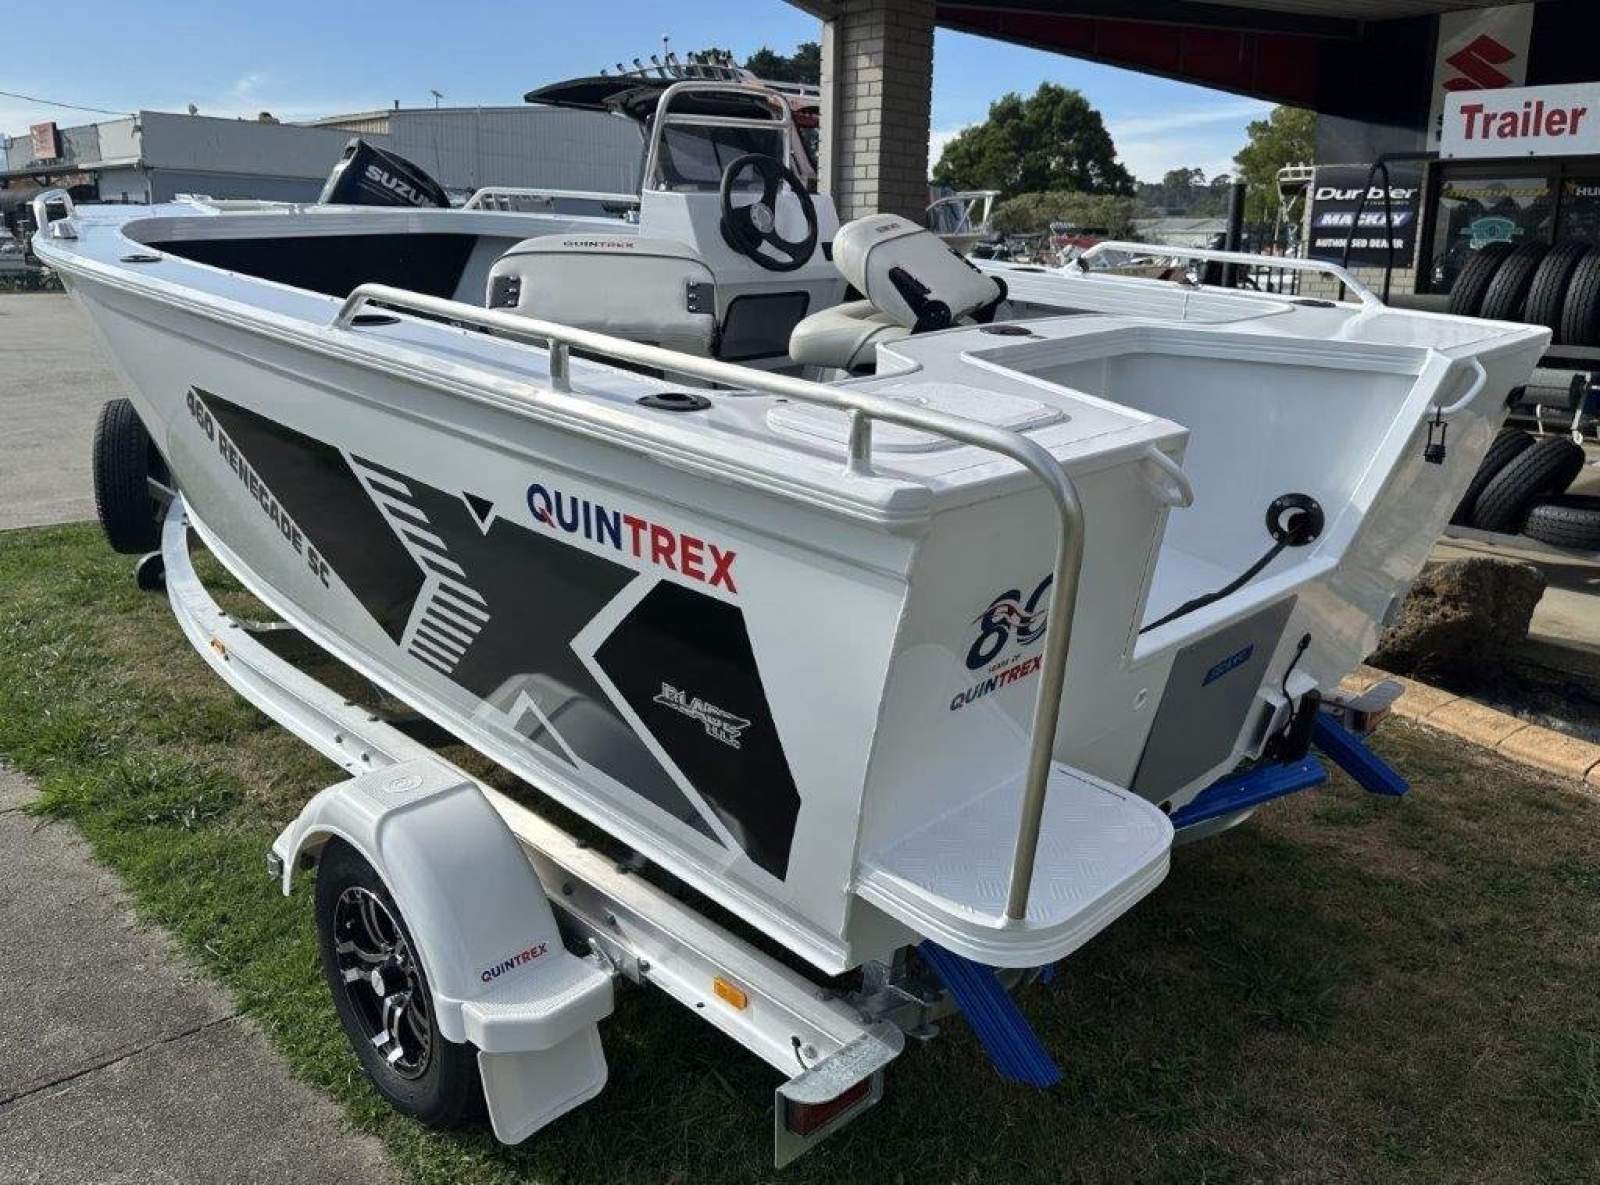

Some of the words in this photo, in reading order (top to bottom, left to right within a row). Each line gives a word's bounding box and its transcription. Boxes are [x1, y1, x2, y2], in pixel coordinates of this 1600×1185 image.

[1460, 101, 1587, 139] Trailer
[1315, 239, 1368, 248] AUTHORSED
[1369, 239, 1404, 249] DEAER
[187, 390, 214, 442] 460
[219, 429, 303, 556] RENEGADE
[308, 546, 330, 589] SC
[527, 483, 738, 595] QUINTREX
[950, 654, 1043, 711] QUINTREX
[480, 942, 548, 983] QUINTREX
